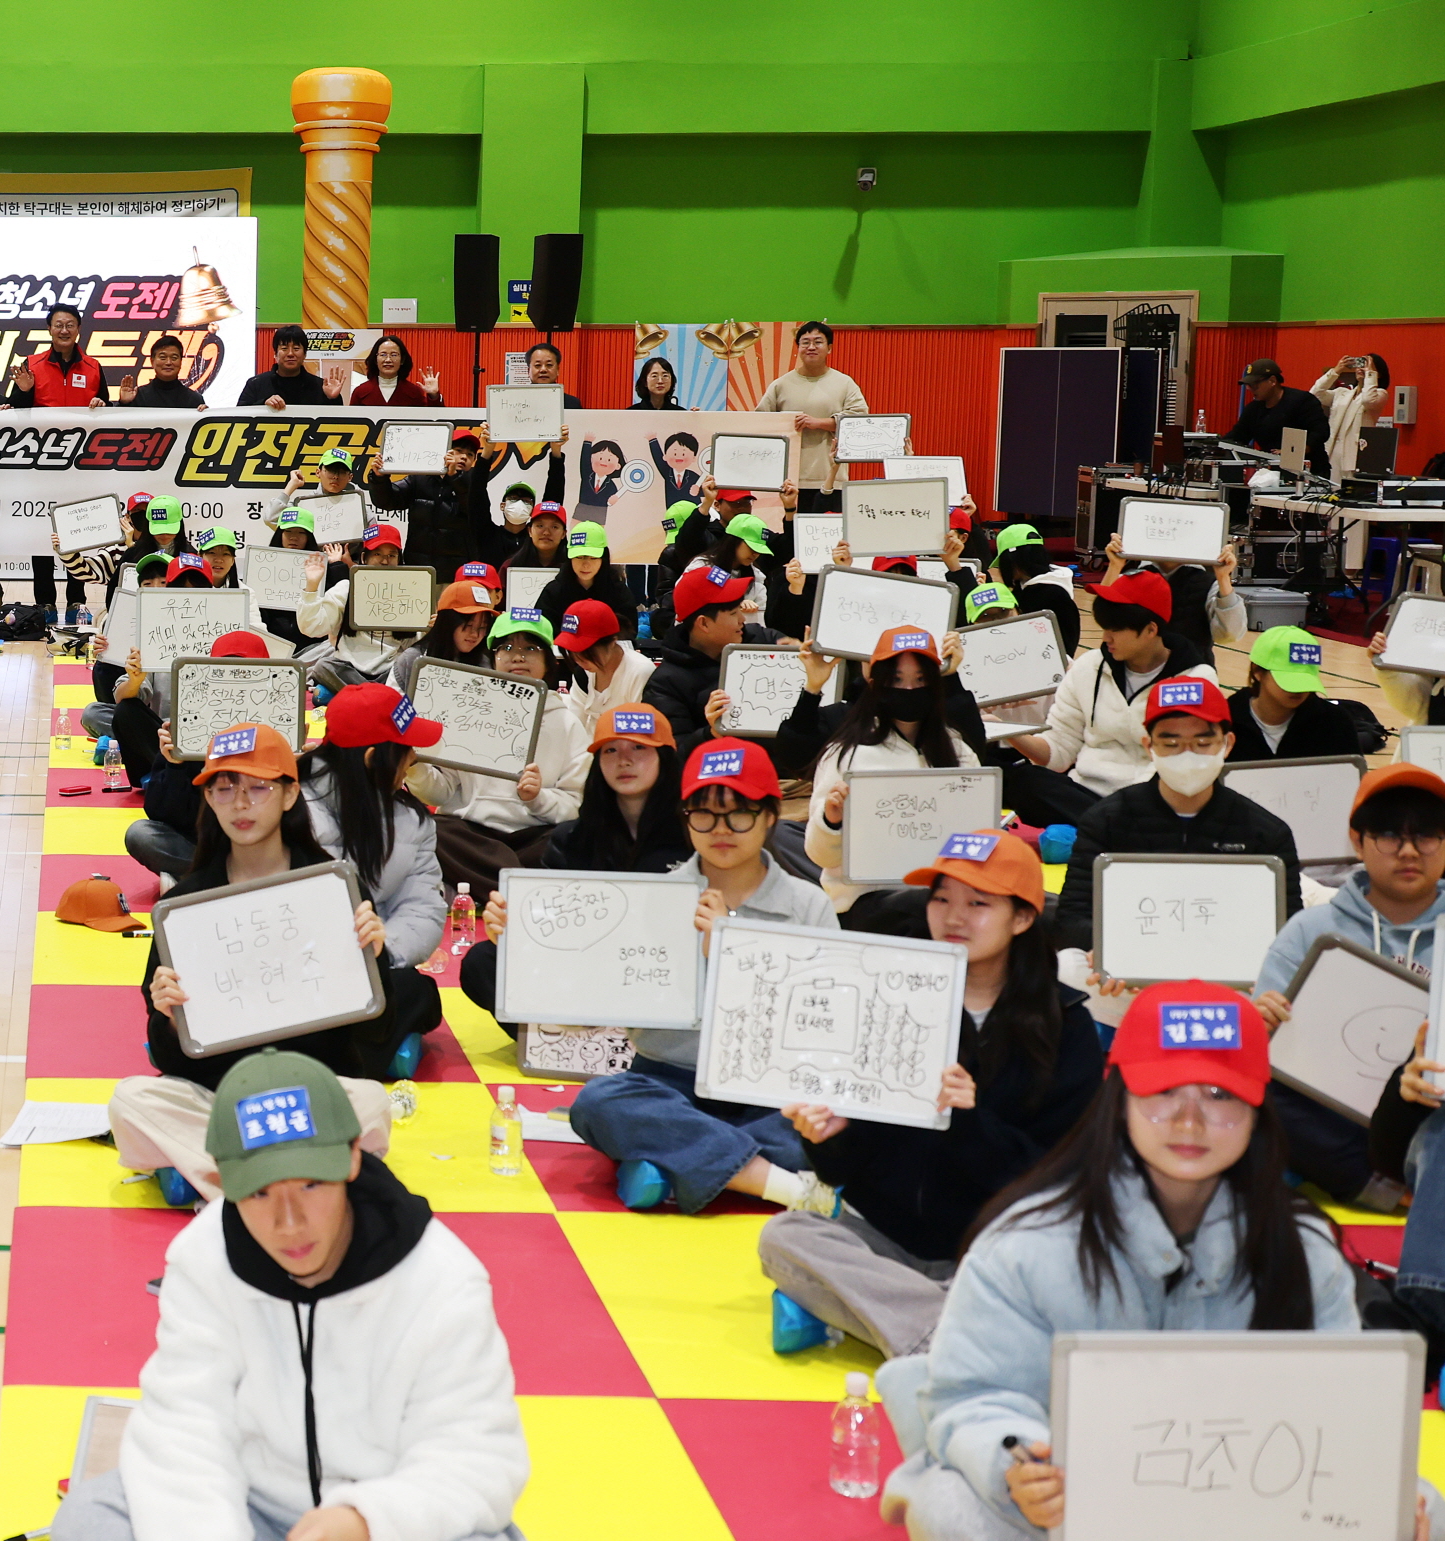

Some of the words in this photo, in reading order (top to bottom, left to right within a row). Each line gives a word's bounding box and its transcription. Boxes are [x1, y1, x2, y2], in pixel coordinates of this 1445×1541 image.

[24, 201, 73, 216] 탁구대는
[77, 201, 114, 216] 본인이
[117, 200, 168, 216] 해체하여
[93, 280, 181, 320] 도전!
[79, 430, 174, 468] 도전!
[805, 524, 843, 541] 만수여
[3, 561, 31, 572] 10:00
[161, 597, 209, 621] 유준서
[210, 688, 247, 707] 정각중
[452, 692, 495, 717] 정각중
[453, 715, 498, 739] 임서연
[1134, 896, 1218, 936] 윤지후
[214, 902, 300, 957] 남동중
[214, 951, 325, 1011] 박현주
[622, 967, 671, 987] 오서연
[1163, 1021, 1237, 1044] 김초아
[1131, 1418, 1336, 1505] 김초아
